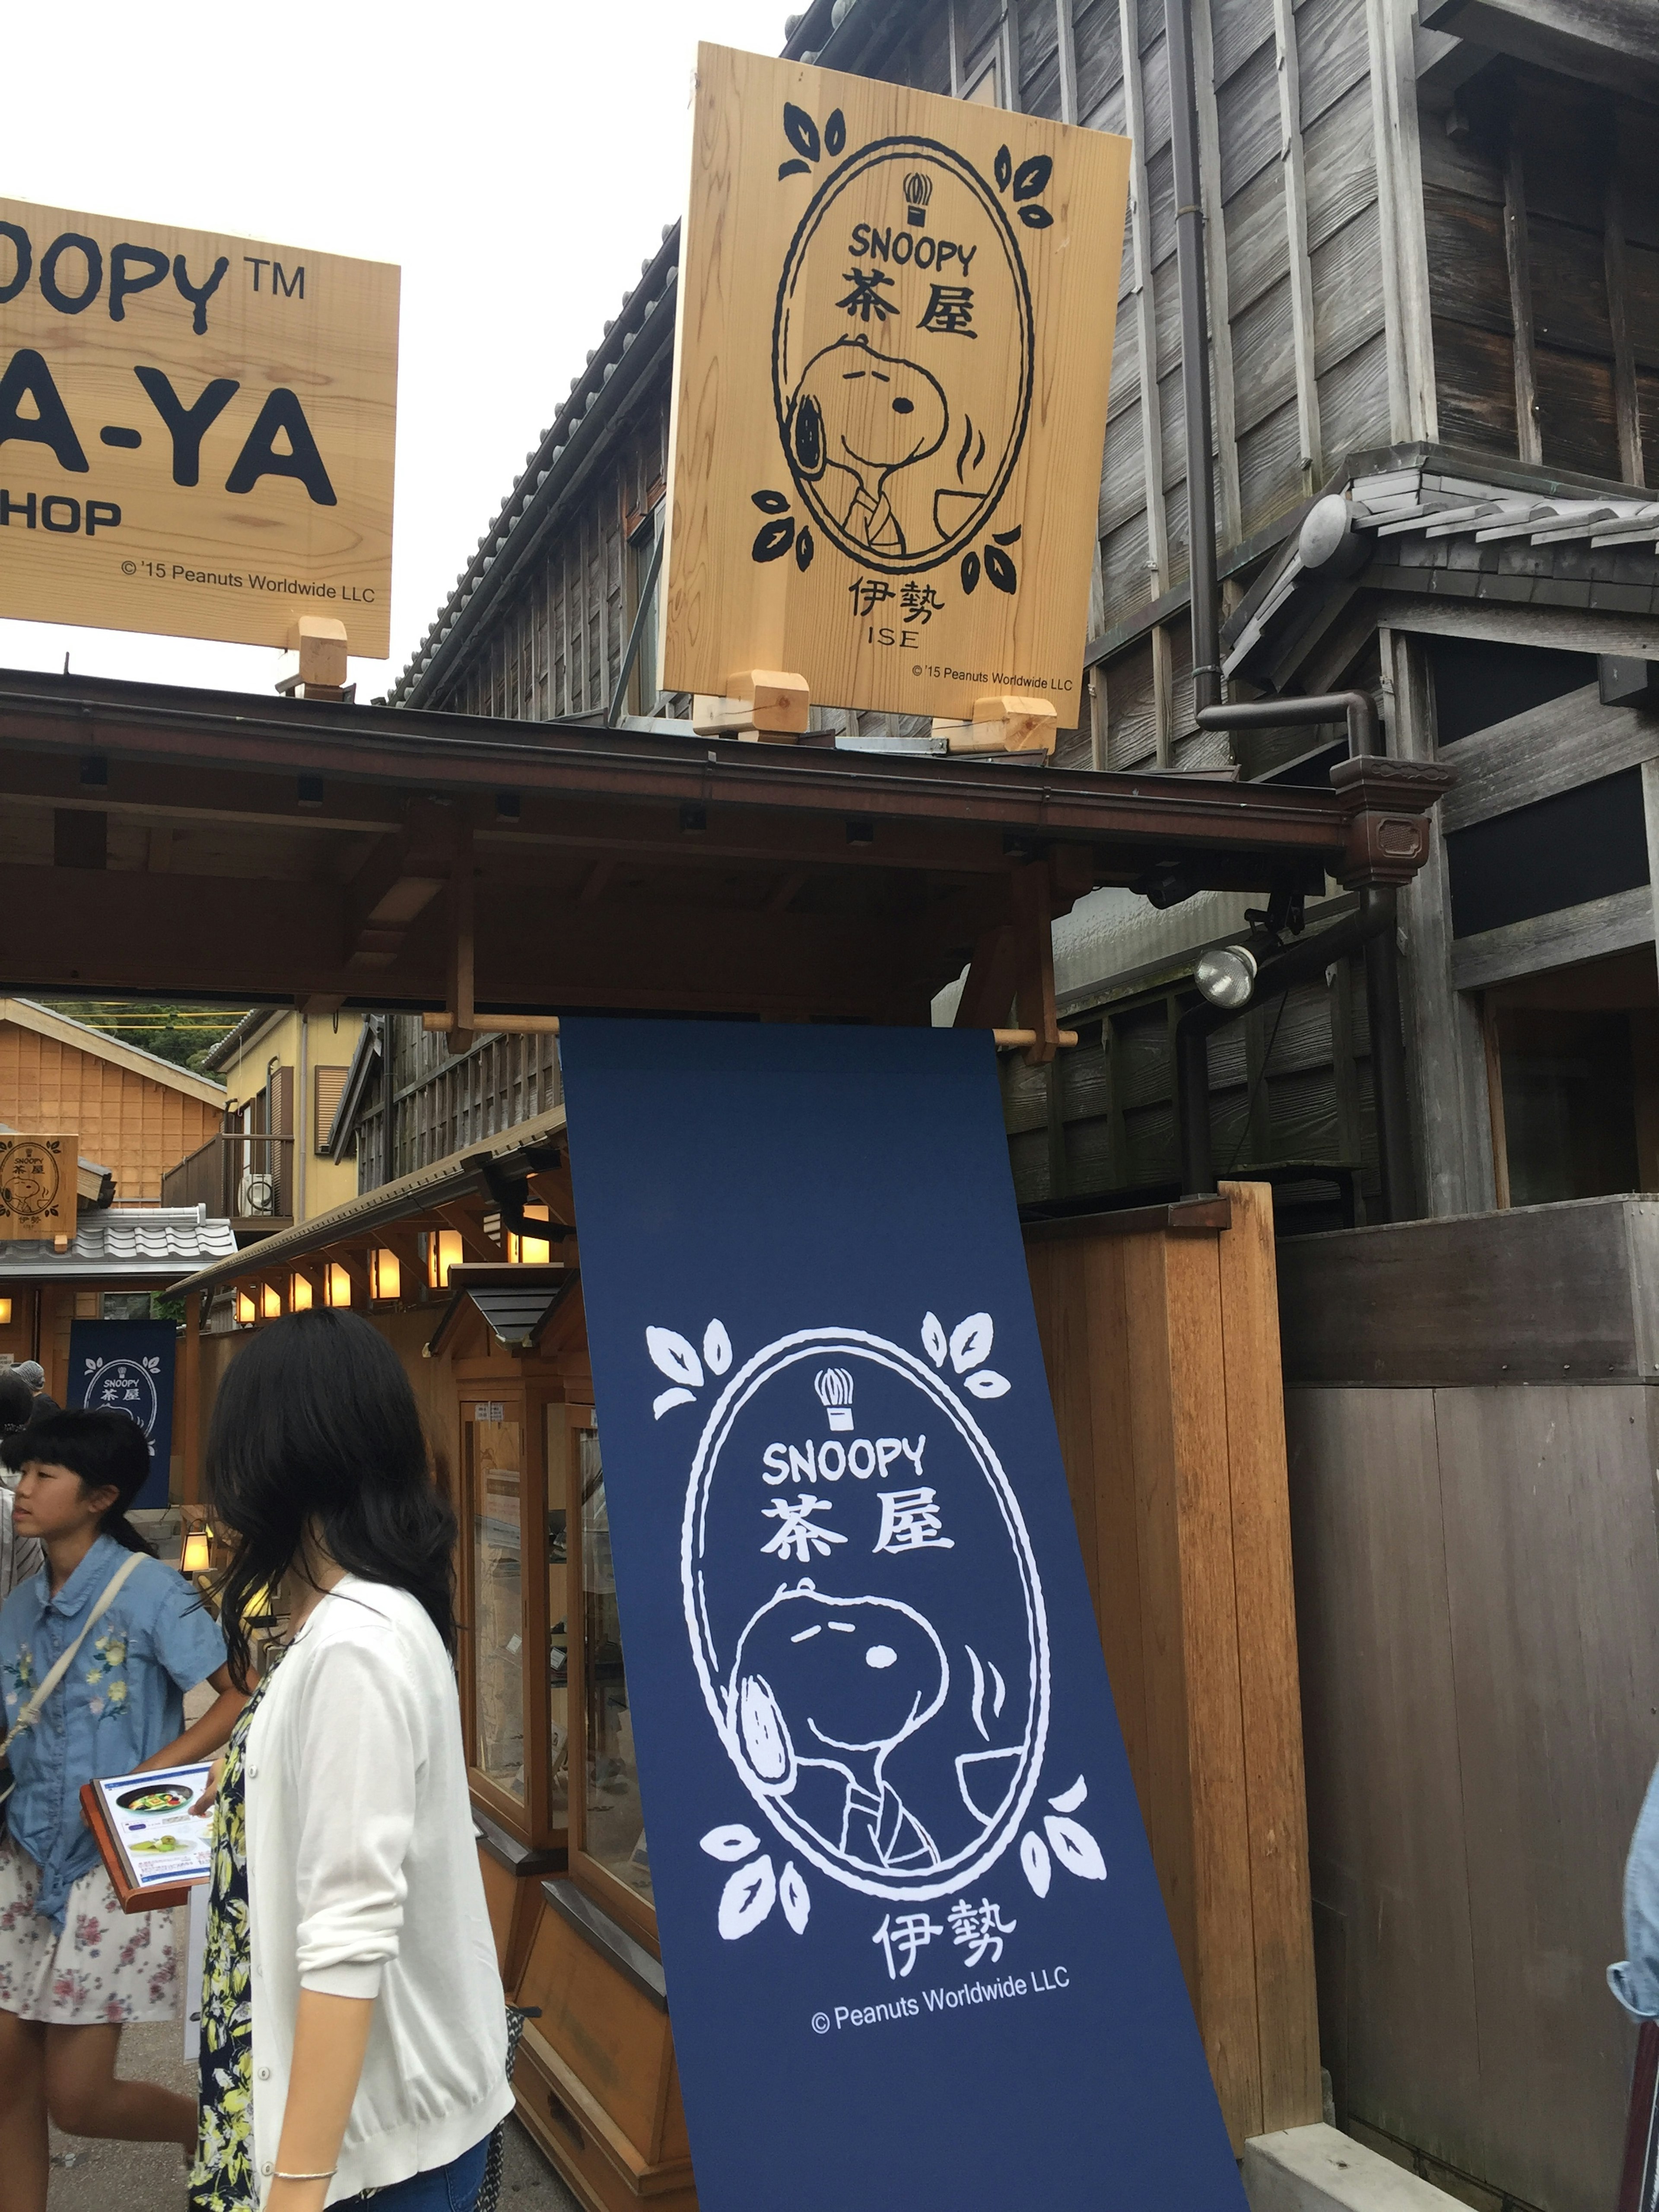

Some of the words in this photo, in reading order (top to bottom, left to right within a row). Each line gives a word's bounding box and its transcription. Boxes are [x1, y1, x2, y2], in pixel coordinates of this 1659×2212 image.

[849, 223, 977, 277] SNOOPY
[835, 267, 978, 339] 茶屋
[0, 349, 337, 506] A-YA
[0, 489, 121, 536] HOP
[172, 565, 243, 587] Peanuts
[248, 574, 337, 598] Worldwide
[342, 586, 375, 603] LLC
[849, 576, 945, 625] 伊勢
[868, 626, 919, 648] ISE
[944, 667, 988, 683] Peanuts
[992, 672, 1048, 689] Worldwide
[1051, 679, 1073, 691] LLC
[100, 1389, 141, 1401] 茶屋
[103, 1379, 139, 1387] SNOOPY
[762, 1434, 926, 1485] SNOOPY
[760, 1486, 955, 1562] 茶屋
[872, 1897, 1017, 1980] 伊勢
[834, 1997, 919, 2029] Peanuts
[922, 1976, 1027, 2012] Worldwide
[1030, 1966, 1070, 1992] LLC
